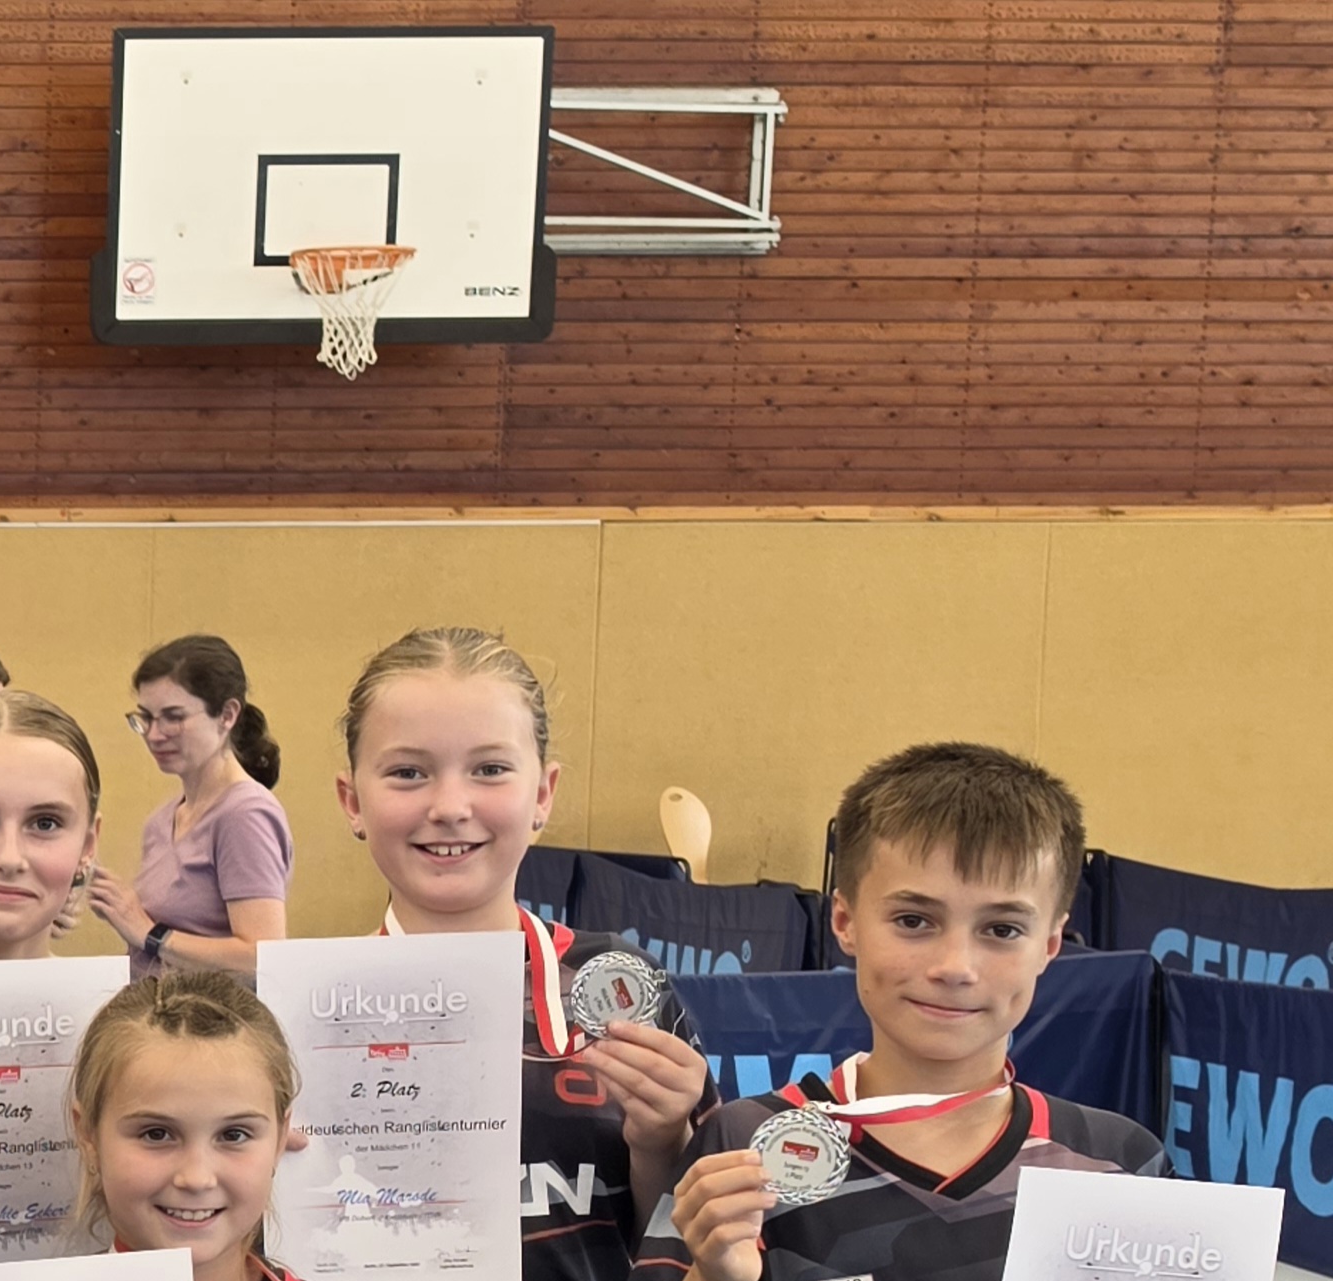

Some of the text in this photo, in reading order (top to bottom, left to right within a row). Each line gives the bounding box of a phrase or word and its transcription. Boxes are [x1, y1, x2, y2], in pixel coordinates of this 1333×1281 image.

[464, 286, 520, 296] BENZ
[311, 982, 468, 1018] Urkunde
[376, 1080, 420, 1101] Platz
[384, 1118, 507, 1135] Ranglistenturnier
[1065, 1225, 1224, 1273] Urkunde
